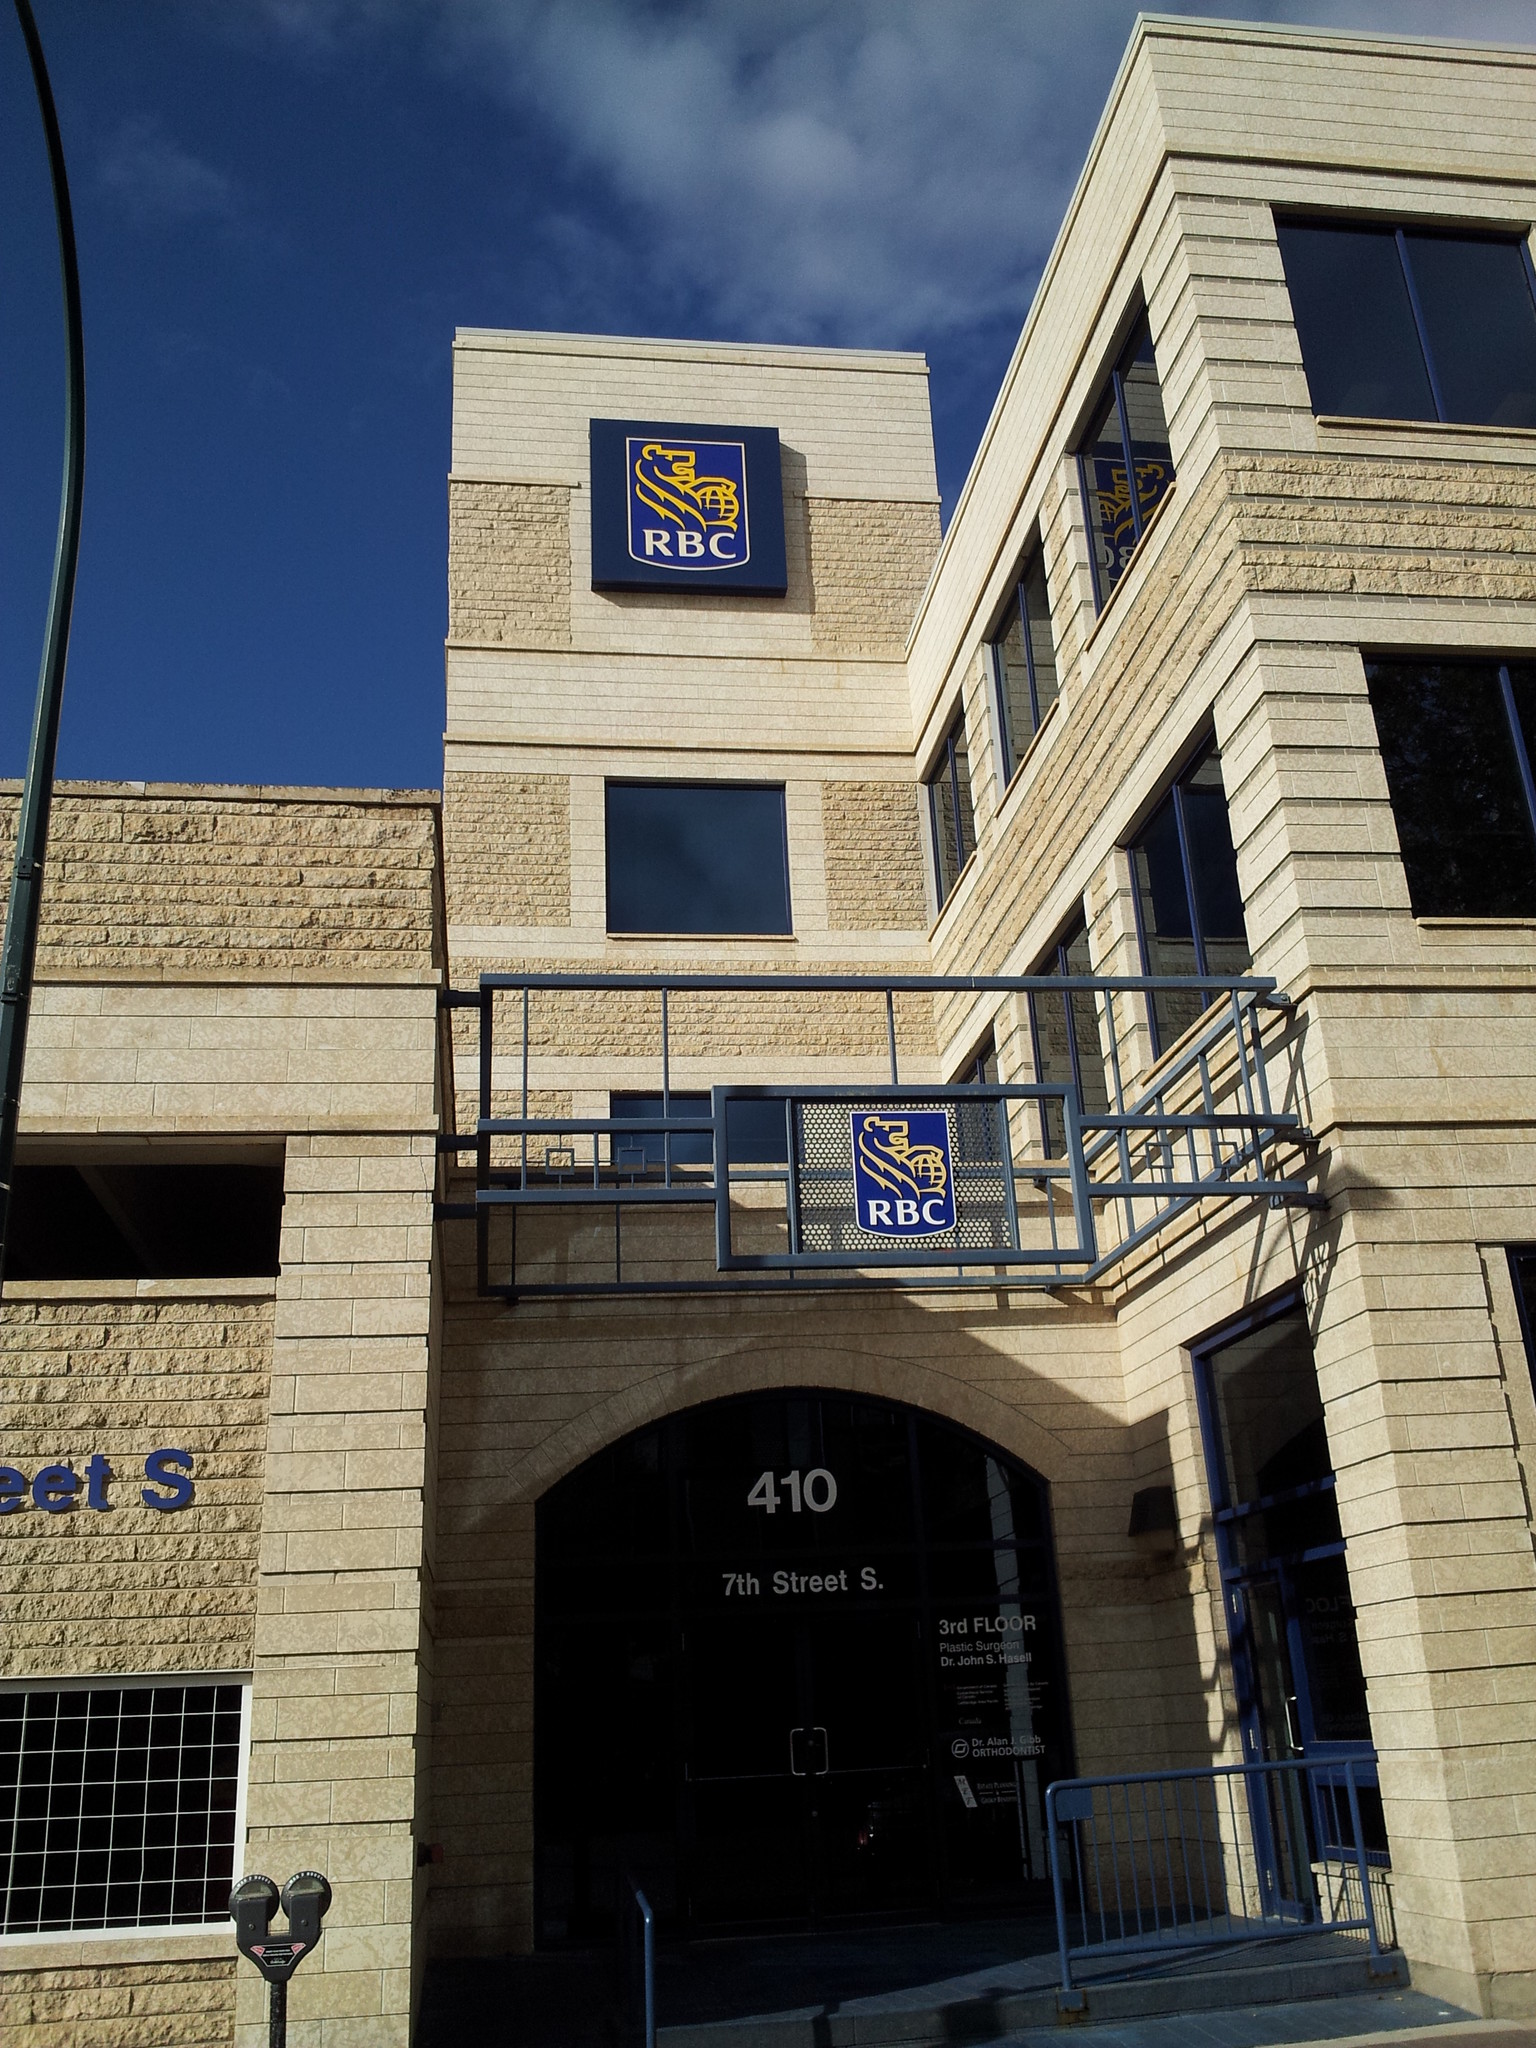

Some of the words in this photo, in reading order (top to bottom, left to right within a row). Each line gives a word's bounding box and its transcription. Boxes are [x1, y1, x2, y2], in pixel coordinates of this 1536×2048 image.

[642, 528, 737, 560] RBC
[866, 1198, 947, 1226] RBC
[142, 1448, 194, 1510] S
[747, 1468, 838, 1514] 410
[722, 1572, 760, 1596] 7th
[772, 1569, 848, 1595] Street
[860, 1566, 884, 1591] S.
[938, 1617, 968, 1635] 3rd
[973, 1615, 1037, 1633] FLOOR
[939, 1641, 974, 1653] Plastic
[975, 1640, 1020, 1653] Surgeon
[940, 1656, 955, 1667] Dr.
[957, 1655, 984, 1666] John
[985, 1653, 997, 1665] S.
[998, 1652, 1032, 1665] Hasell
[971, 1738, 985, 1748] Dr.
[987, 1736, 1008, 1747] Alan
[972, 1745, 1046, 1758] ORTHODONTIST
